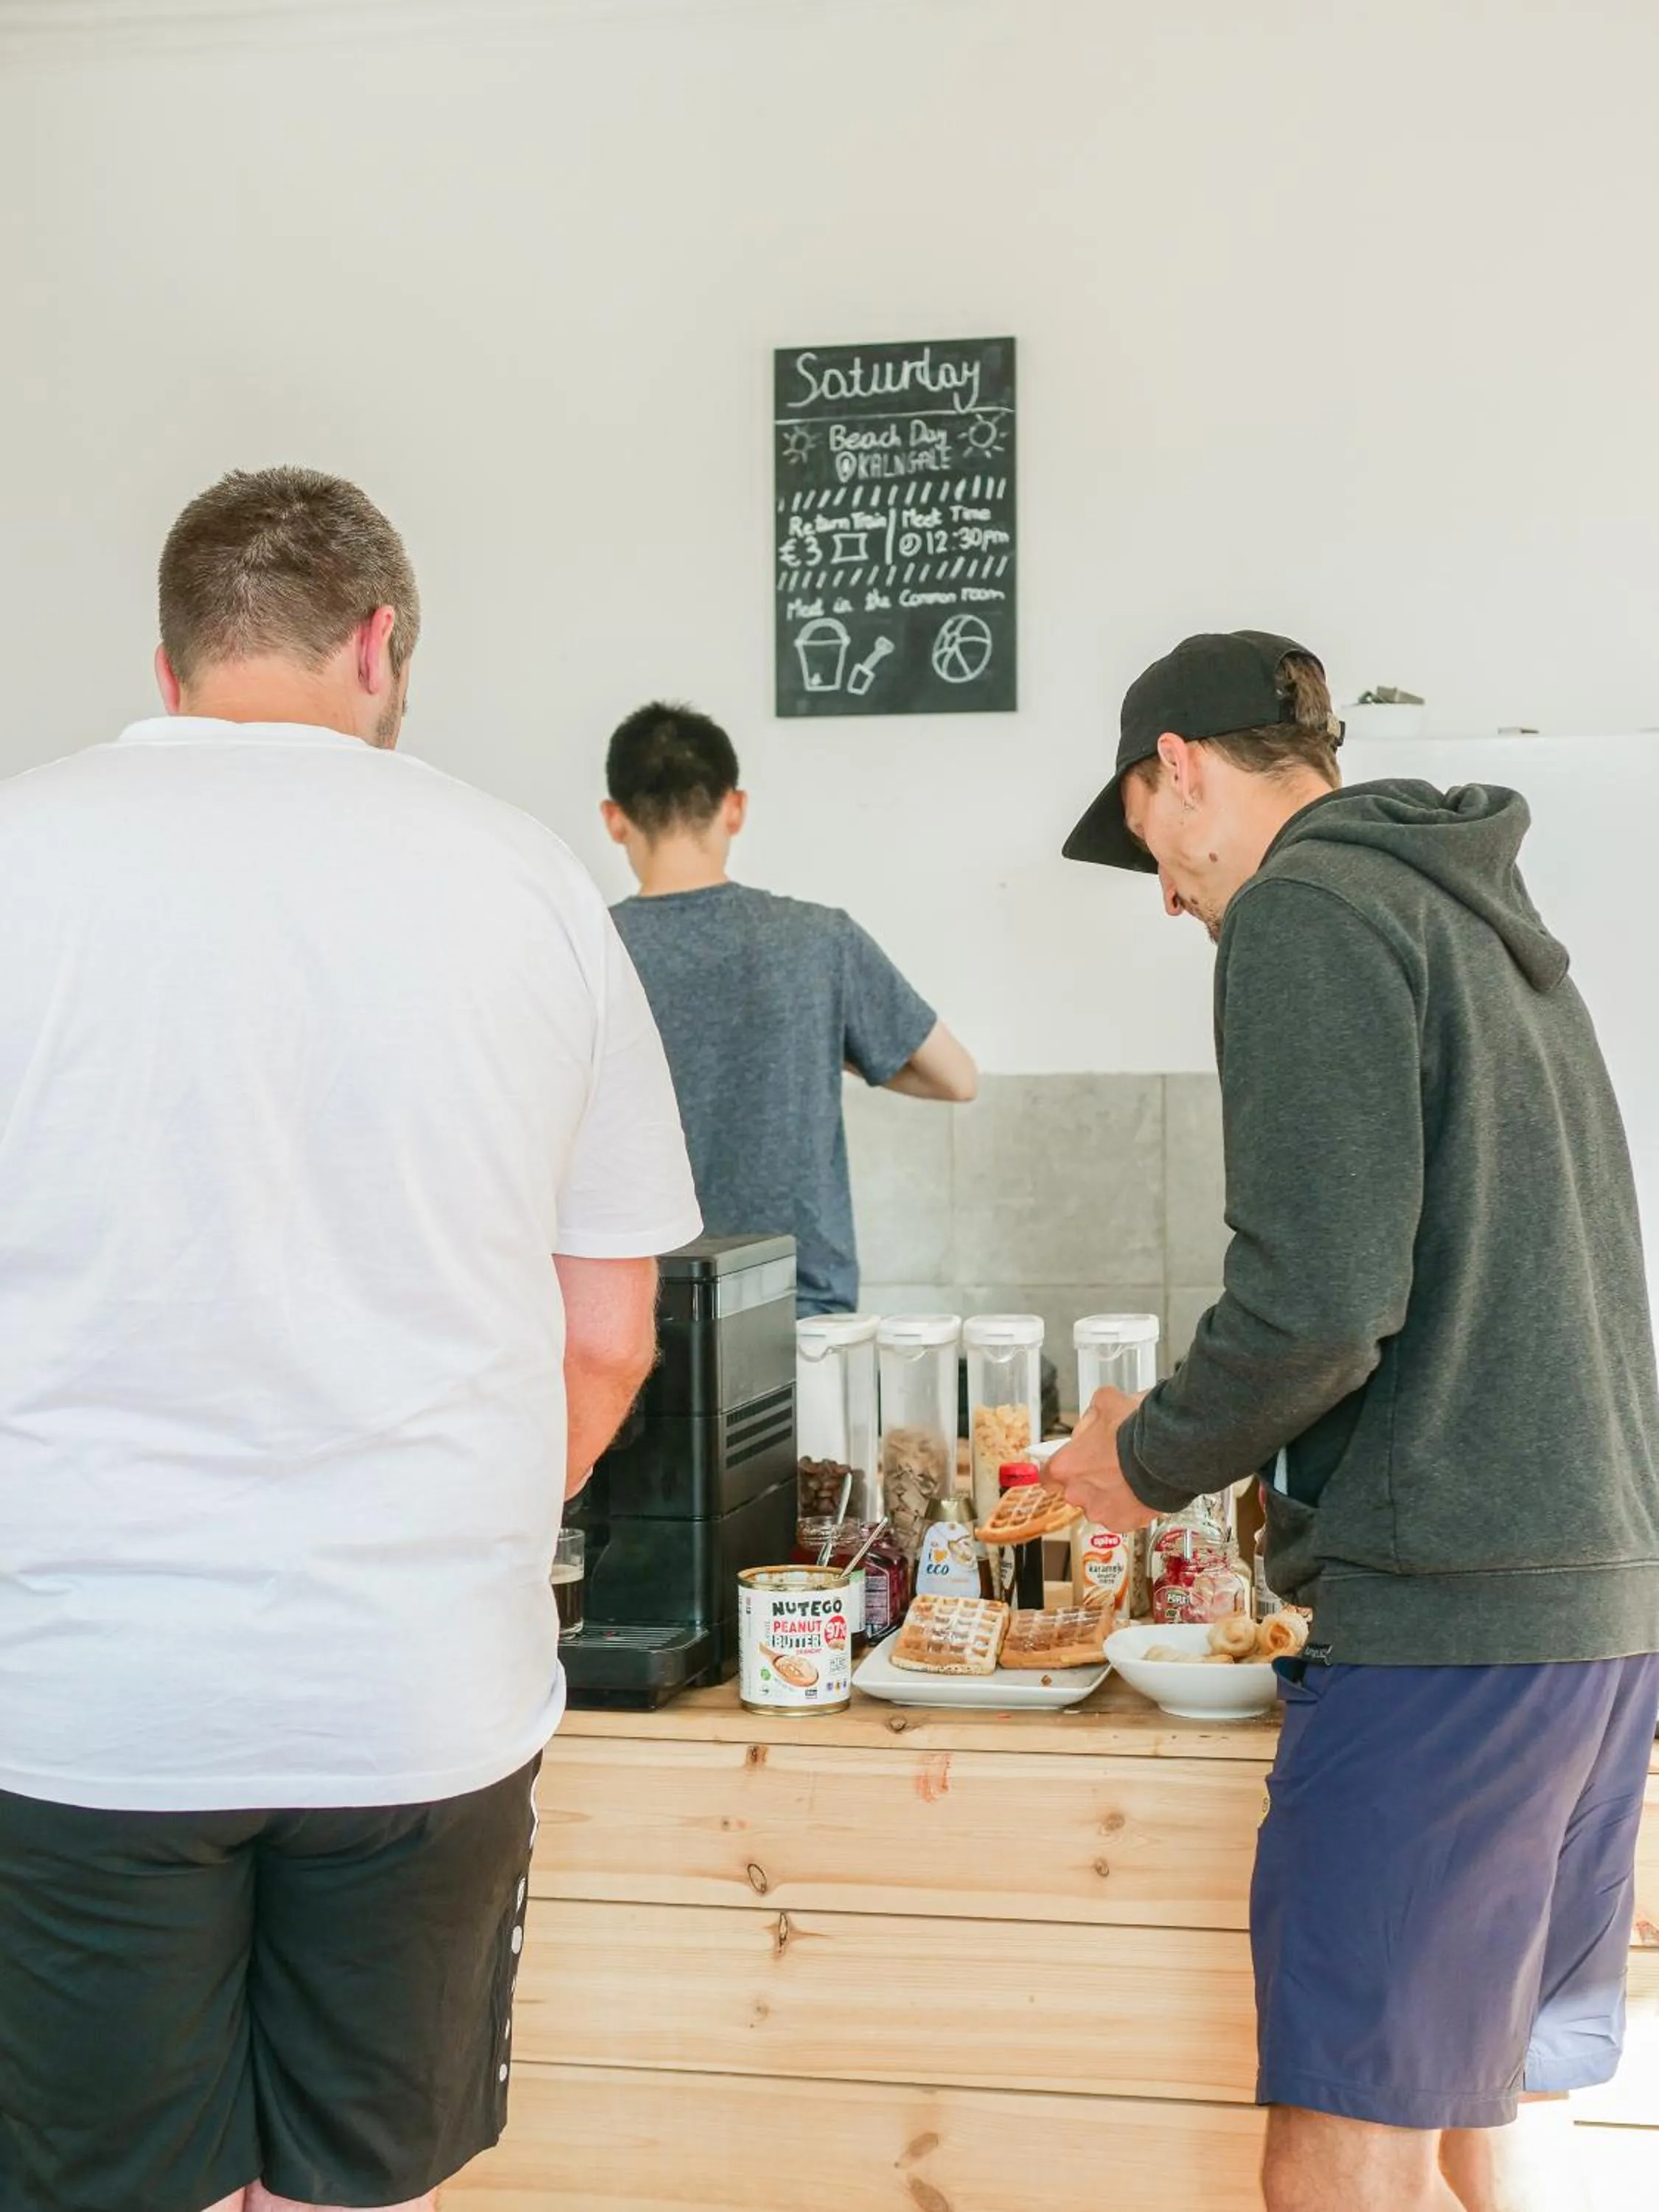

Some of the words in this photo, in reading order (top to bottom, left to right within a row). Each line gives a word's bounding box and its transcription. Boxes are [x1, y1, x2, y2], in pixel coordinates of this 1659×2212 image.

[787, 346, 980, 414] Saturday
[830, 423, 901, 451] Beach
[910, 420, 947, 448] Day
[788, 514, 850, 538] Return
[902, 507, 943, 529] Meet
[949, 505, 992, 523] Time
[779, 535, 823, 567] €3
[786, 598, 824, 621] Meet
[832, 597, 853, 613] in
[864, 588, 891, 612] the
[961, 587, 1005, 602] room
[927, 1564, 949, 1575] eco
[773, 1620, 821, 1633] PEANUT
[772, 1633, 821, 1648] BUTTER
